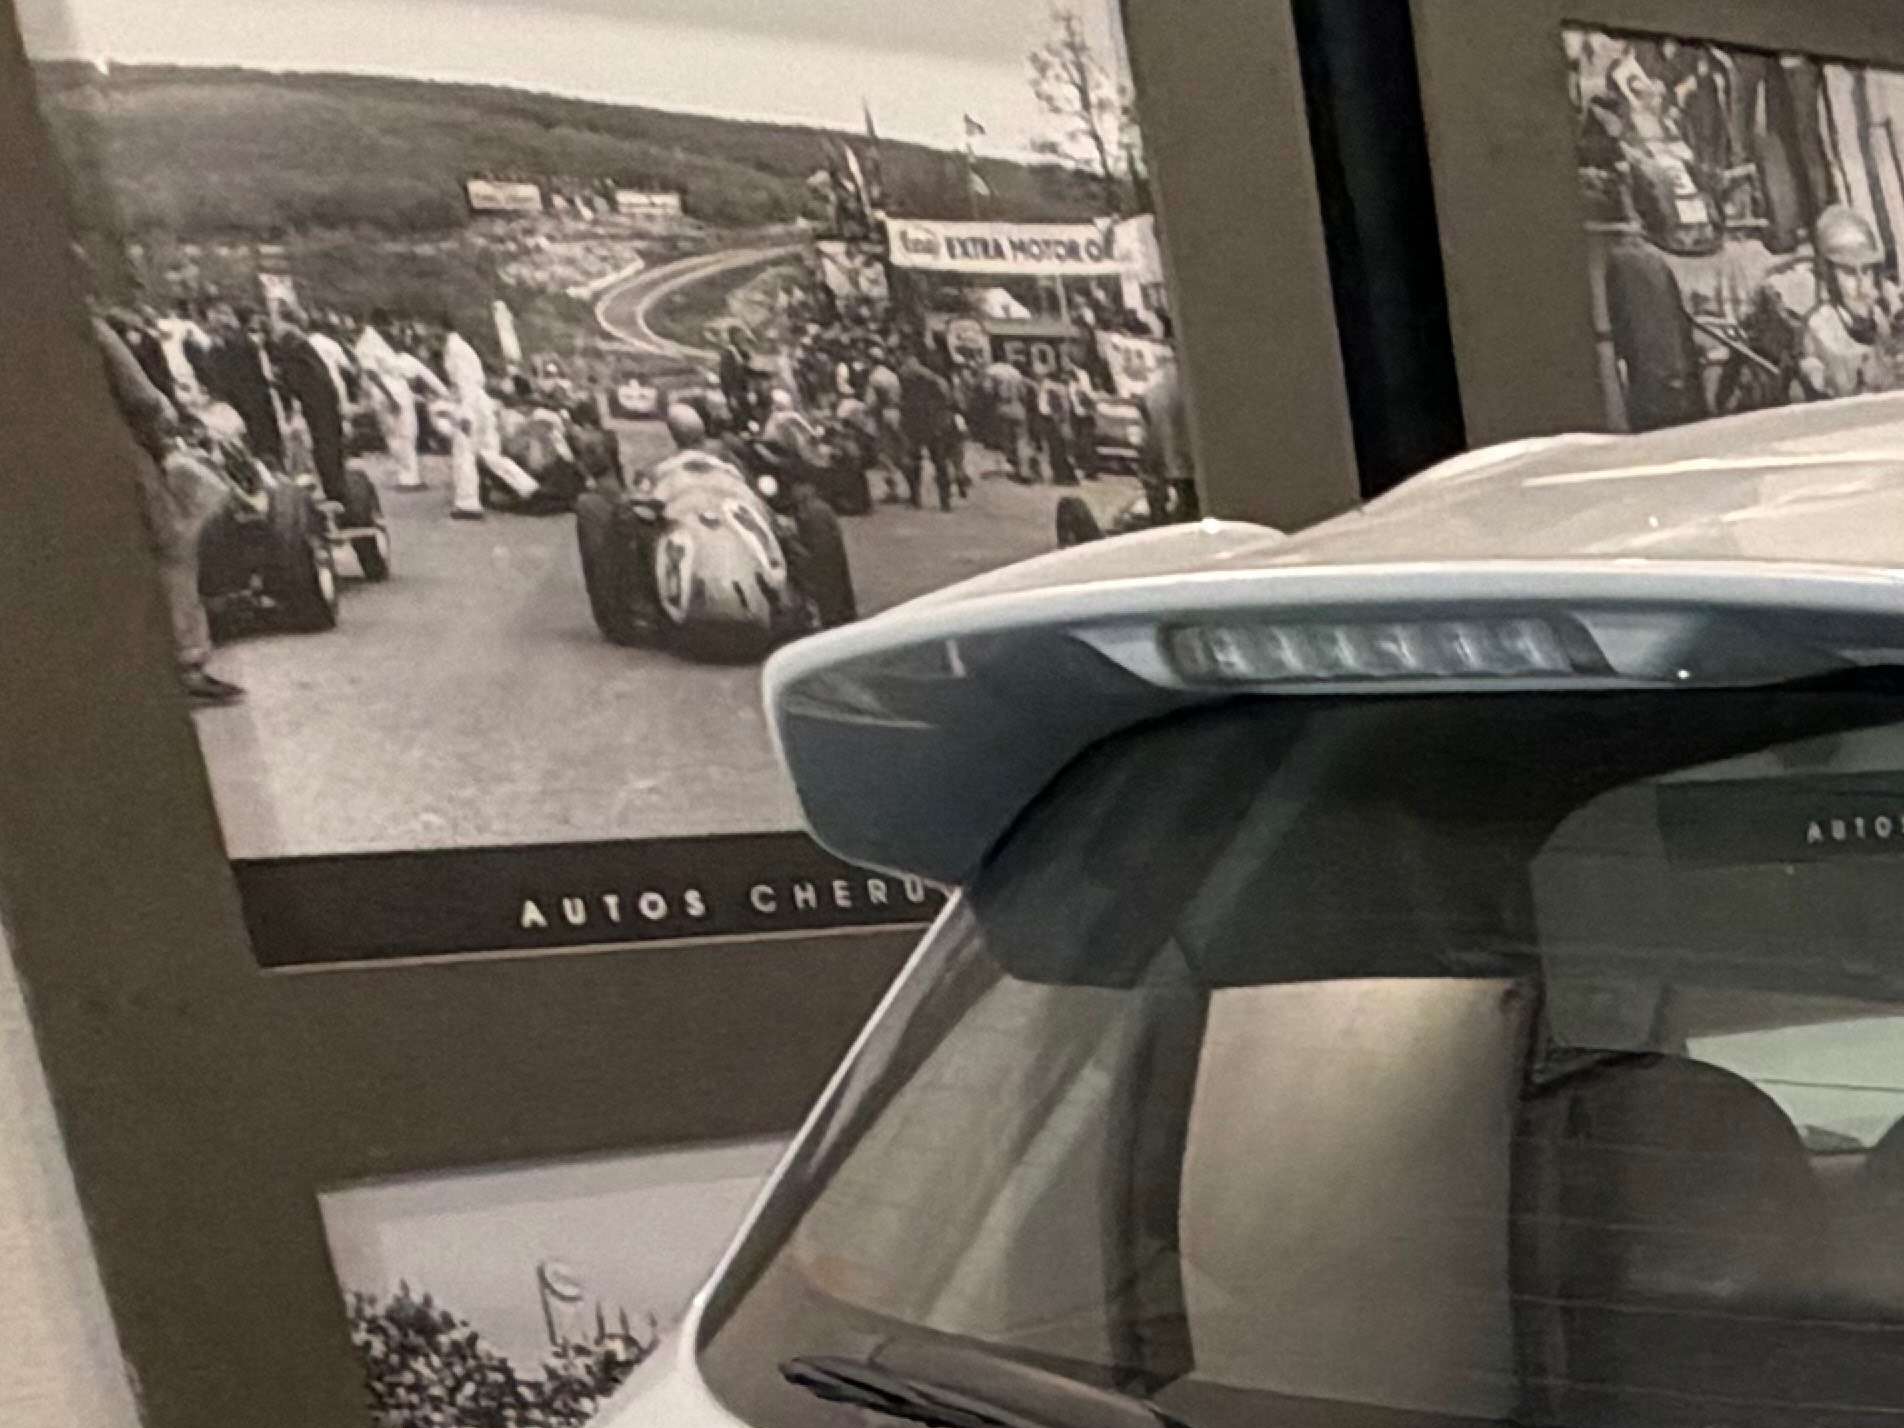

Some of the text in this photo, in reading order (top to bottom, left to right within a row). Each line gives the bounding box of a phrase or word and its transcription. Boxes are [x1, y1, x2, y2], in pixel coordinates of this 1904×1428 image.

[1007, 235, 1082, 262] MOTOR
[520, 875, 926, 928] AUTOS CHERU
